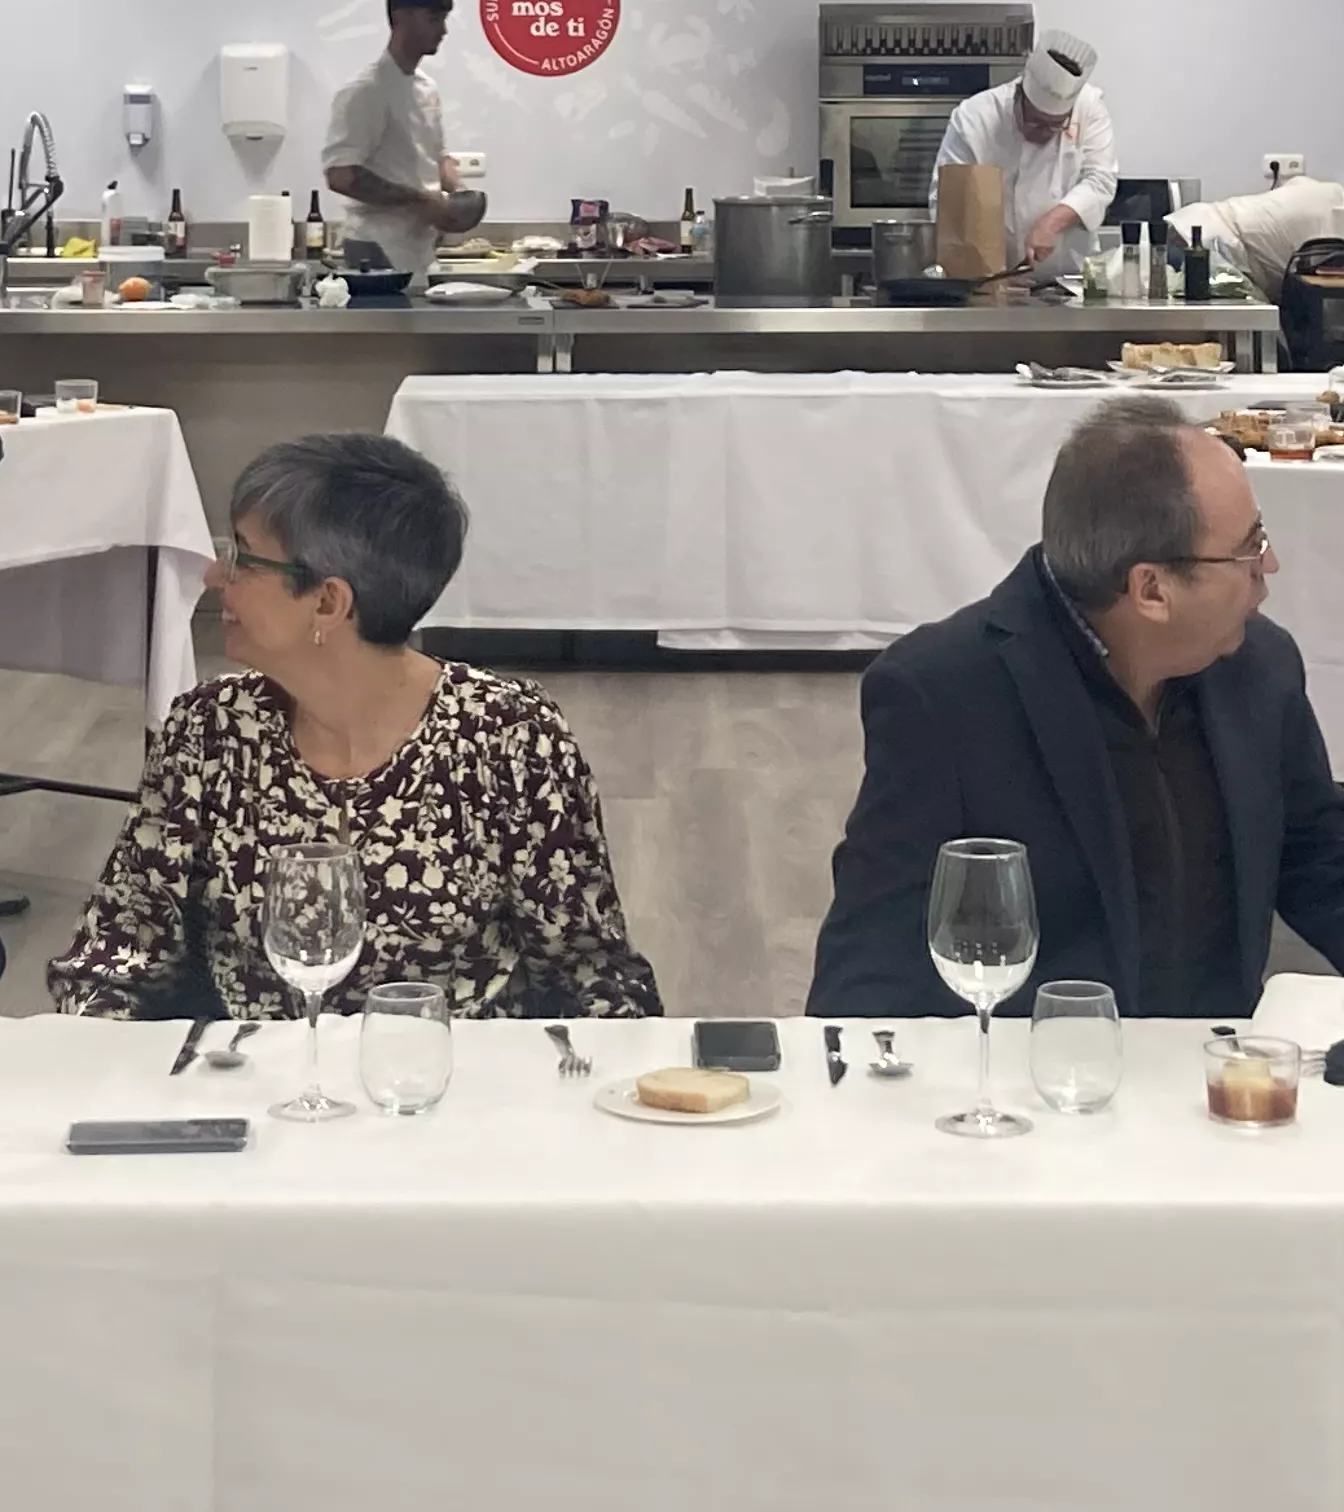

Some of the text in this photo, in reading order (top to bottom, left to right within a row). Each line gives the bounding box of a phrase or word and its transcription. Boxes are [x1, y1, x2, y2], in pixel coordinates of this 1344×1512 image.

[511, 0, 564, 17] mos
[530, 17, 586, 37] de ti
[541, 8, 615, 71] ALTOARAGÓN
